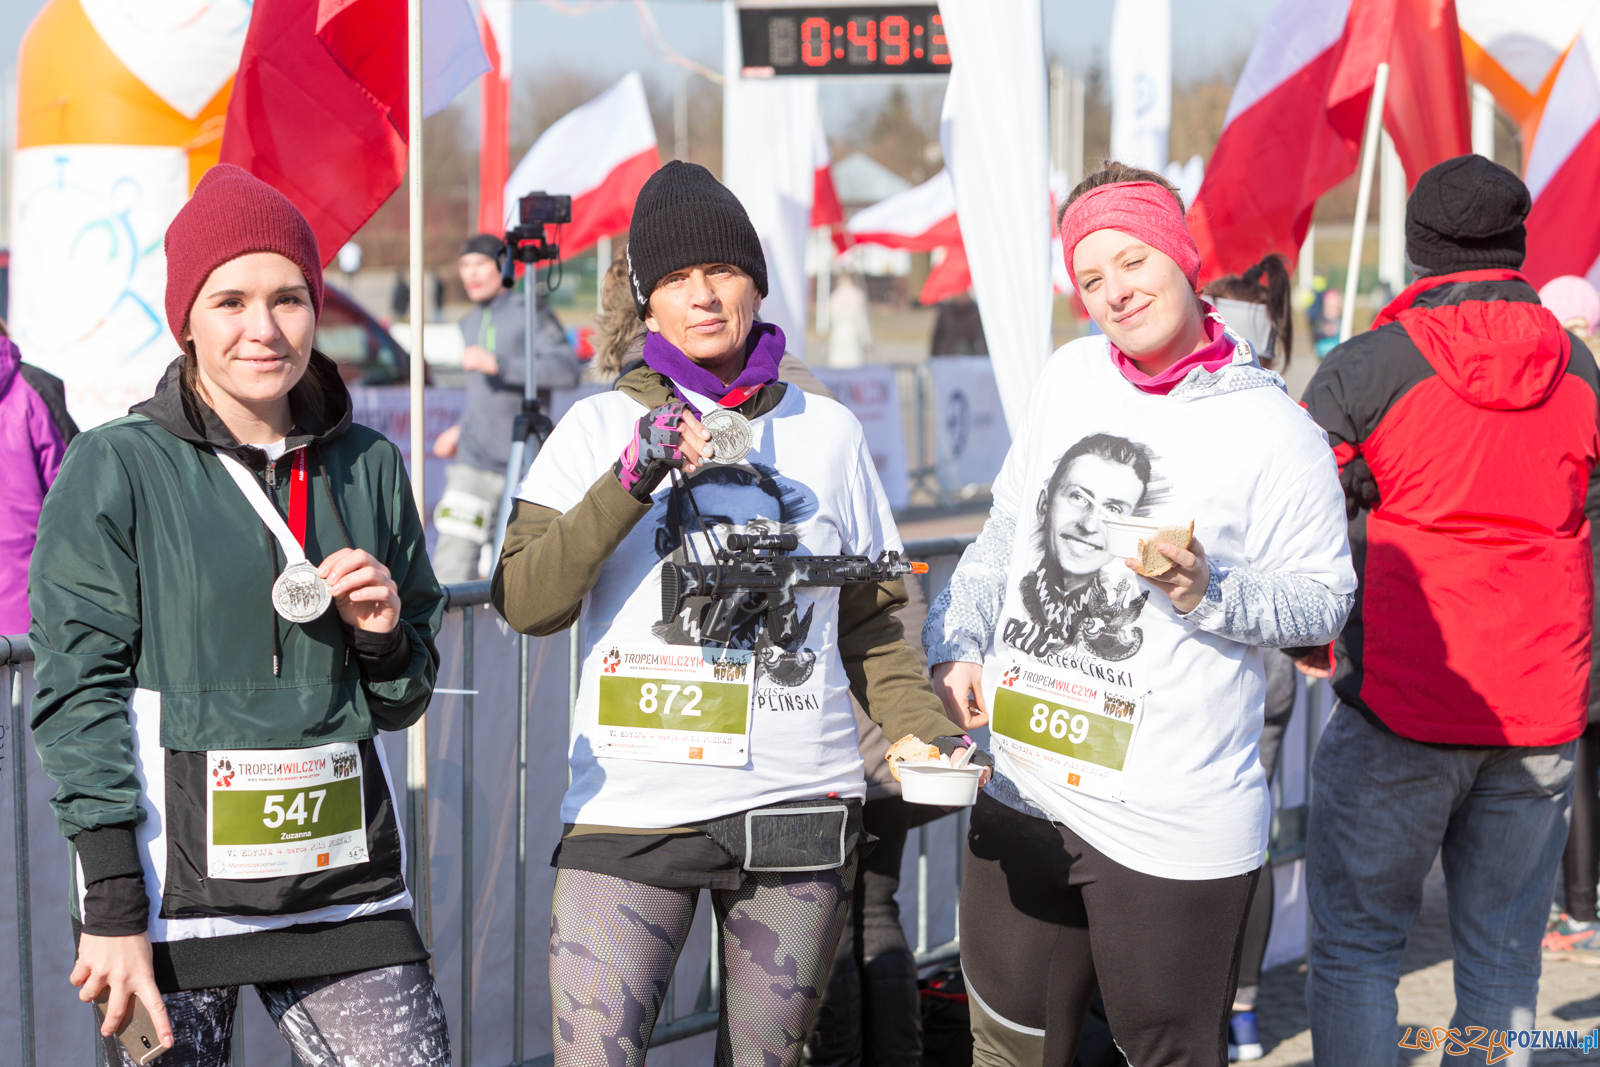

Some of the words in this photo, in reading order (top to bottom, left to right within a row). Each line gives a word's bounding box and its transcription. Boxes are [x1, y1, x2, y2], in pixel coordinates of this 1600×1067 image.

[624, 654, 704, 668] TROPEMWILCZYM
[755, 677, 784, 696] kasz
[1022, 670, 1098, 700] TROPEMWILCZYM
[639, 682, 703, 716] 872
[758, 692, 819, 711] PLIŃSKI
[1029, 703, 1089, 744] 869
[238, 758, 326, 776] TROPEMWILCZYM
[263, 789, 327, 828] 547
[281, 831, 312, 840] Zuzanna
